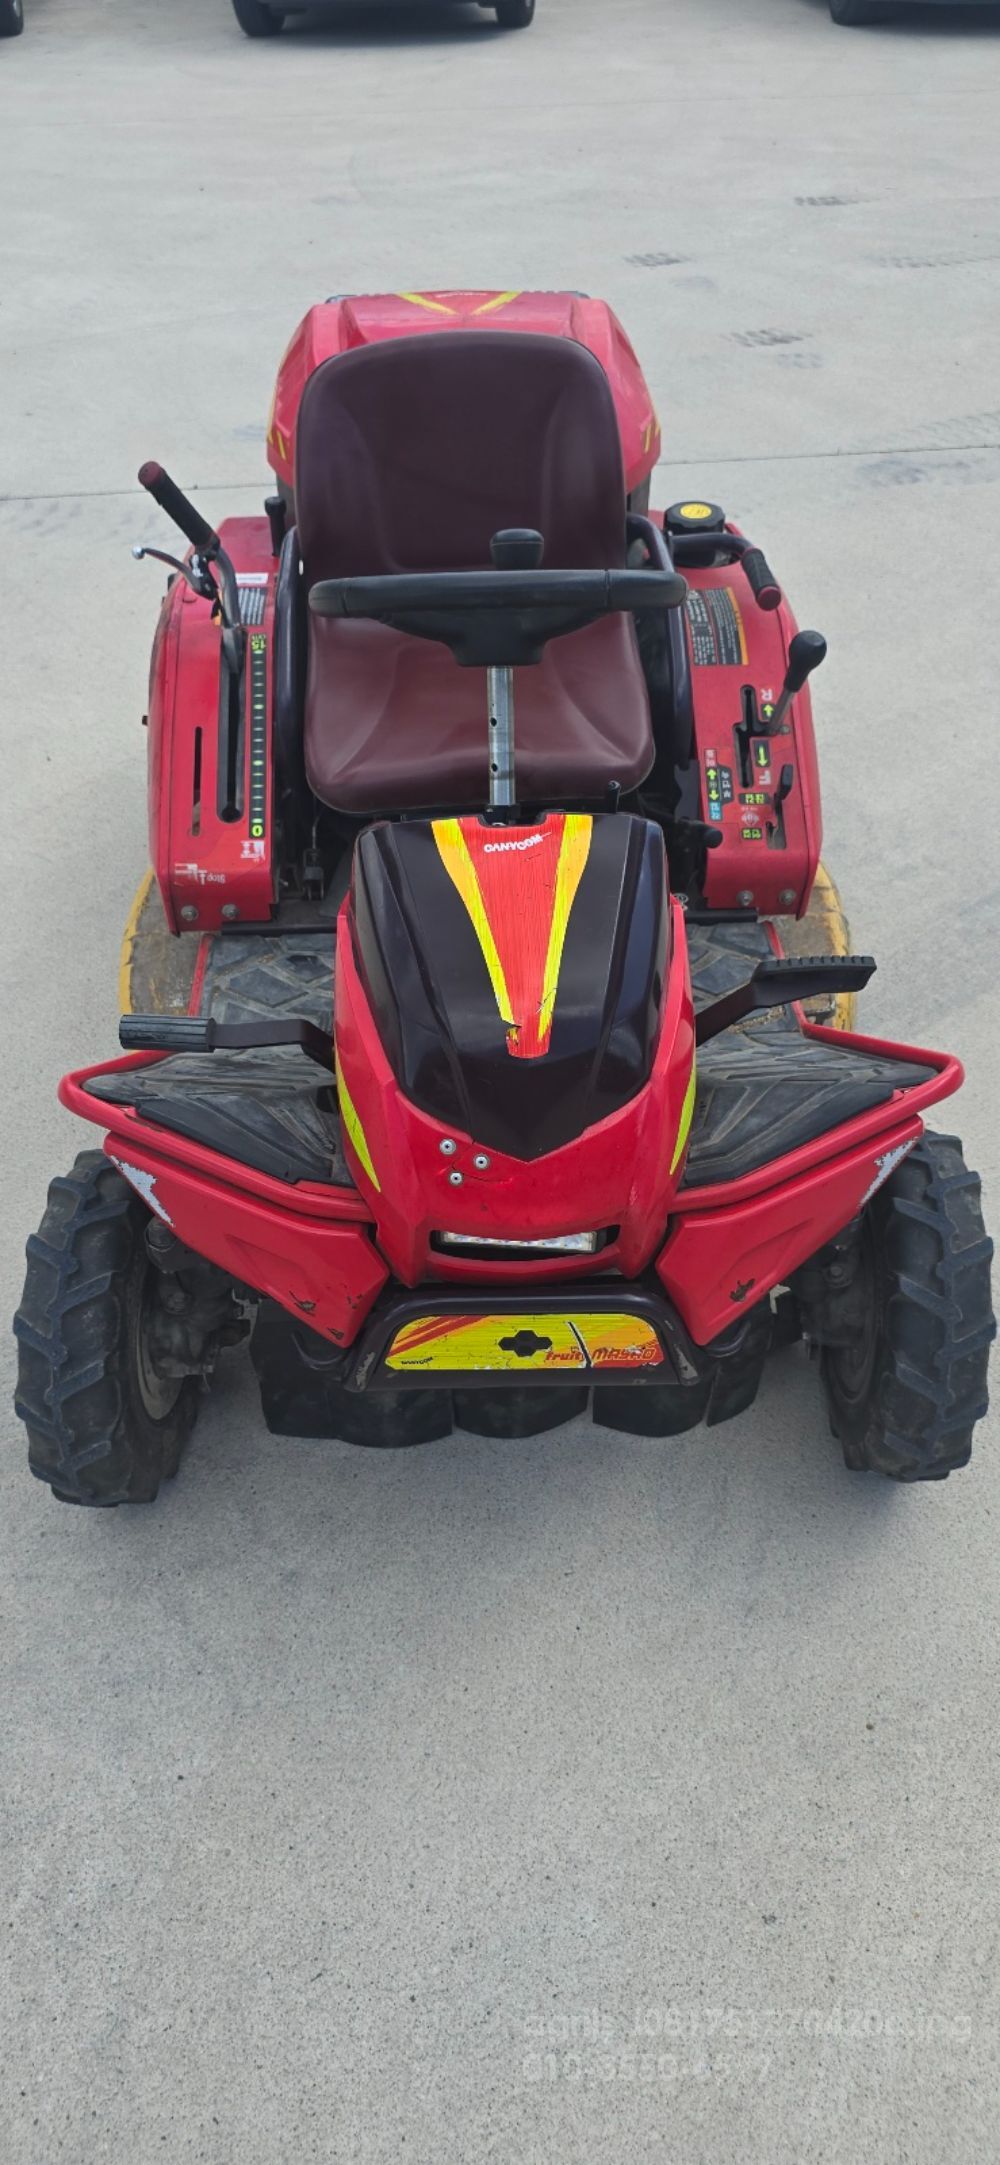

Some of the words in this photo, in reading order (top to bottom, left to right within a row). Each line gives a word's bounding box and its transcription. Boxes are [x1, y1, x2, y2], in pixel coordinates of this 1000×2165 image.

[760, 688, 773, 701] R
[758, 770, 772, 785] F
[251, 825, 264, 837] 0
[484, 833, 544, 852] CANYCOM
